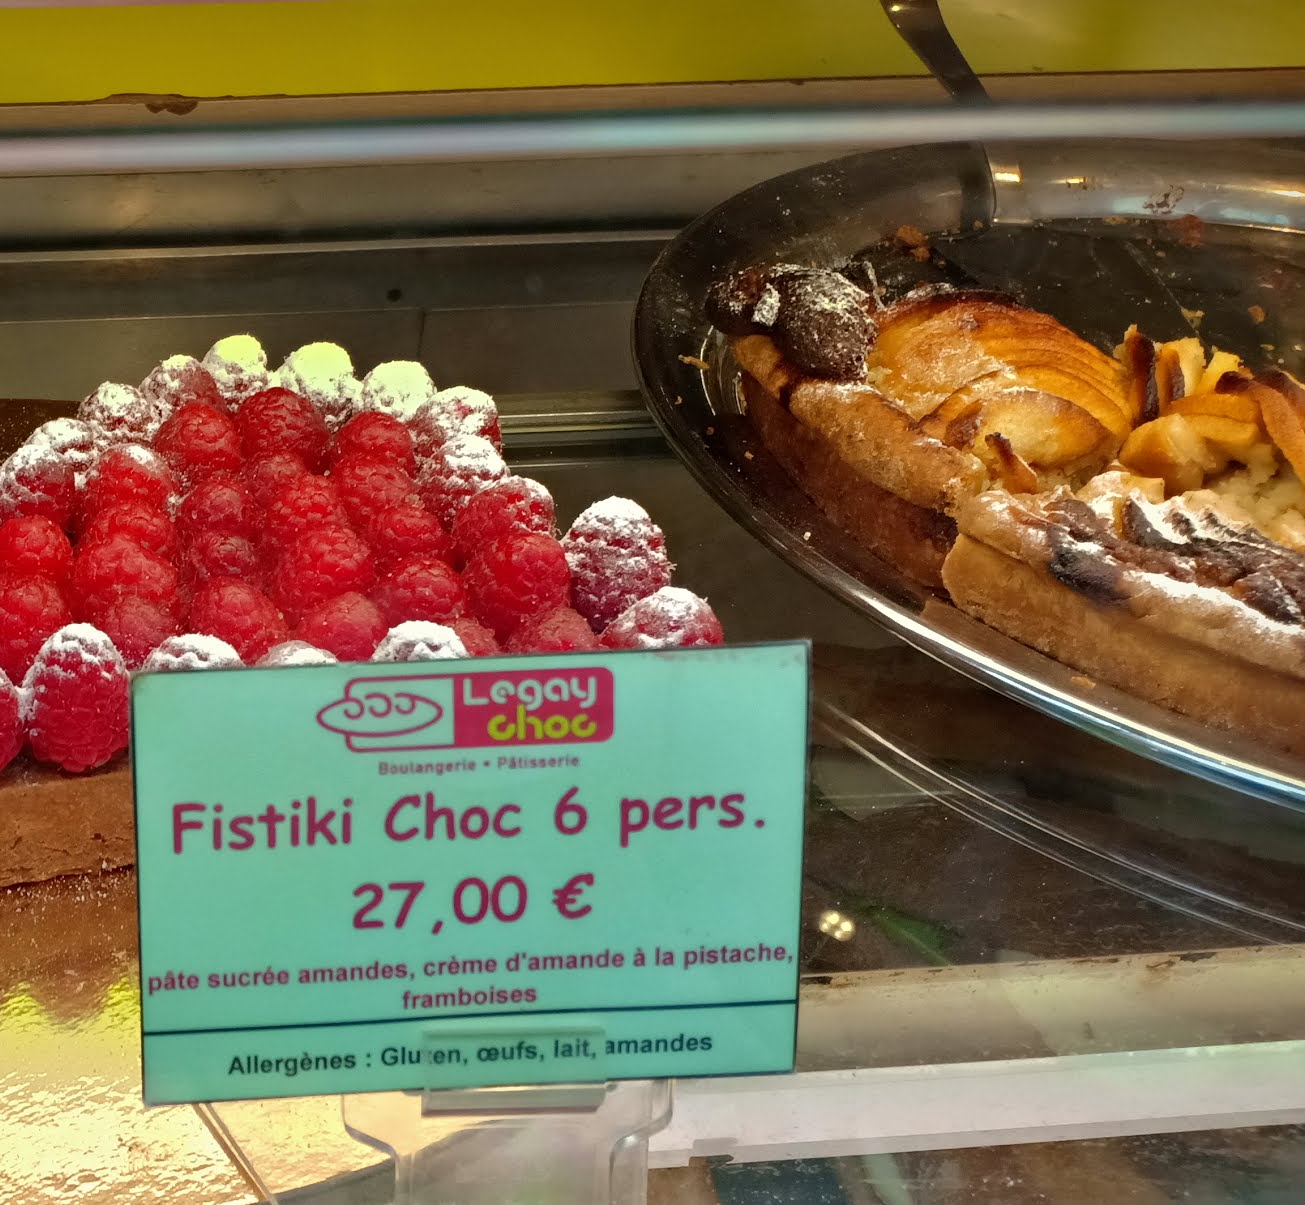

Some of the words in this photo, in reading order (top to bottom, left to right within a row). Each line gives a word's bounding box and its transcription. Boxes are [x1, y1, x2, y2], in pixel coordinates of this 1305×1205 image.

[463, 676, 597, 710] Legay
[487, 704, 597, 741] choc
[378, 758, 477, 777] Boulangerie
[497, 754, 580, 770] Pâtisserie
[173, 797, 352, 854] Fistiki
[385, 792, 521, 841] Choc
[555, 787, 587, 835] 6
[620, 794, 764, 848] pers.
[353, 875, 527, 934] 27,00
[553, 873, 594, 918] €
[148, 970, 199, 996] pâte
[208, 967, 289, 988] sucrée
[298, 960, 415, 984] amandes,
[424, 956, 497, 976] crème
[506, 950, 624, 971] d'amande
[633, 947, 646, 967] à
[655, 946, 675, 966] la
[684, 942, 794, 968] pistache,
[403, 986, 536, 1008] framboises
[228, 1053, 357, 1077] Allergènes
[477, 1041, 544, 1062] œufs,
[553, 1038, 596, 1060] lait,
[606, 1034, 712, 1054] amandes
